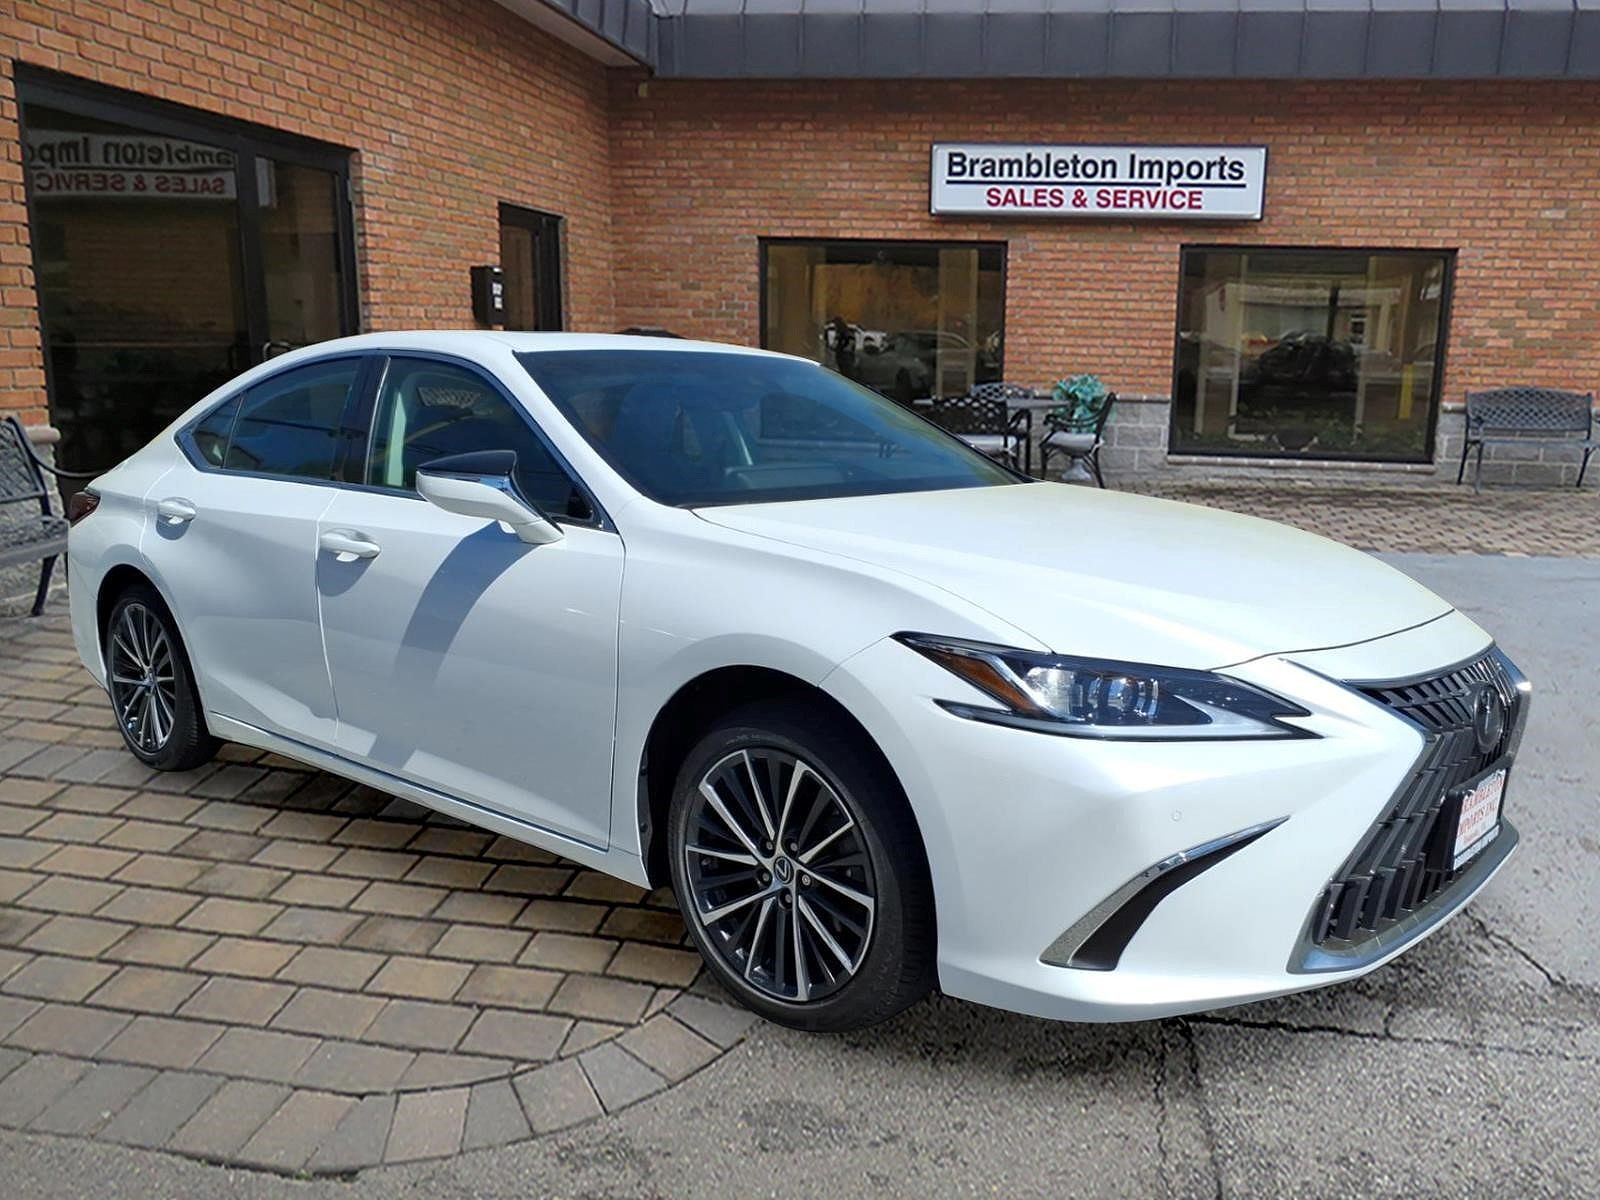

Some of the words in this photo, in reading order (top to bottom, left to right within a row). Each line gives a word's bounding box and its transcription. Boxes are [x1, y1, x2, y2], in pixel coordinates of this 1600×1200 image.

[948, 152, 1118, 179] Brambleton
[1130, 153, 1245, 186] Imports
[986, 187, 1065, 208] SALES
[1071, 188, 1088, 208] &
[1096, 188, 1203, 209] SERVICE
